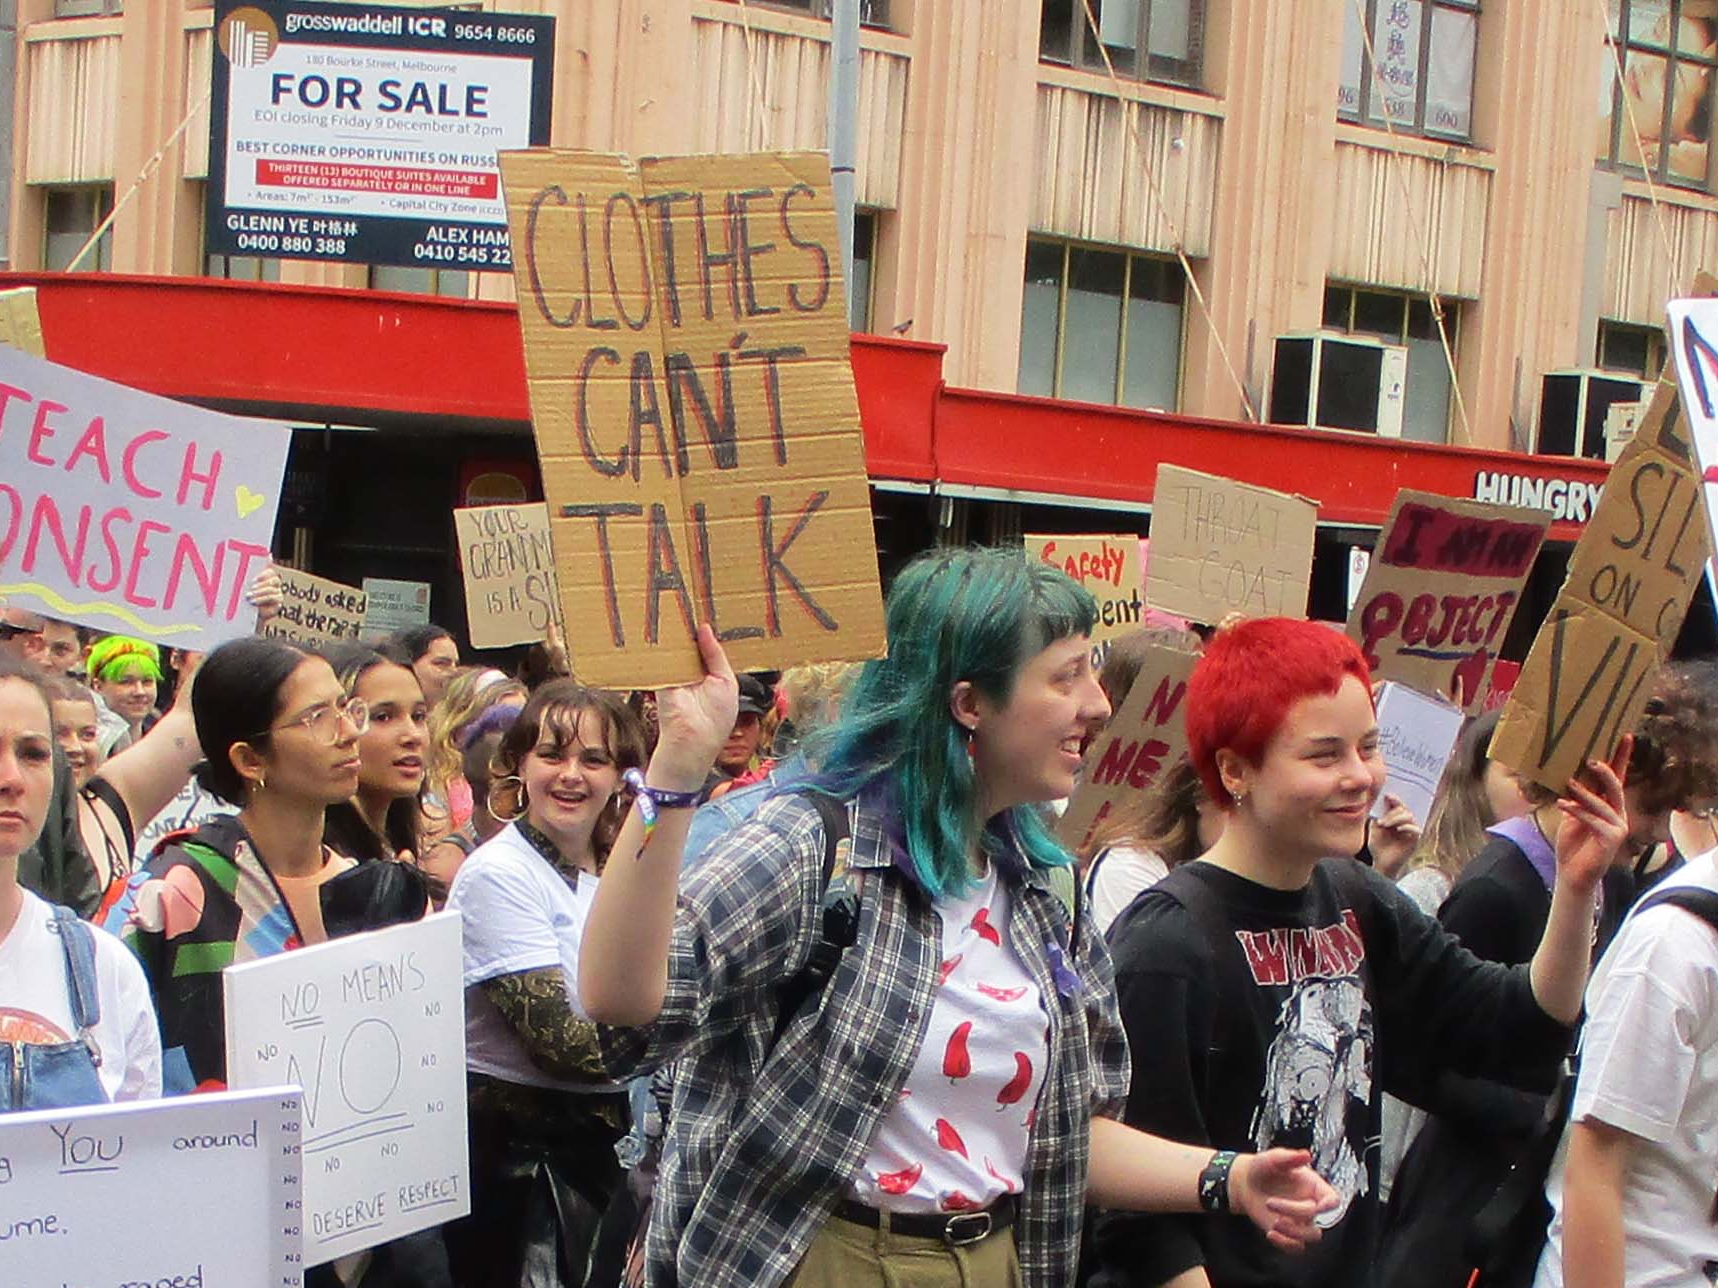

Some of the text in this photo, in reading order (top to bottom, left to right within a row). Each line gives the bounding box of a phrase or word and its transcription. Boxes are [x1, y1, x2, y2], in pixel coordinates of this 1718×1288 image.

[285, 13, 536, 43] grosswaddell ICR 9654 8666
[326, 55, 363, 69] Bourke
[402, 60, 458, 73] Melbourne
[271, 73, 490, 118] FOR SALE
[279, 111, 328, 128] closing
[331, 113, 372, 130] Friday
[374, 117, 384, 130] 9
[386, 117, 454, 134] December
[456, 123, 471, 135] at
[473, 124, 503, 138] 2pm
[236, 141, 458, 165] BEST CORNER OPPORTUNITIES ON
[268, 163, 319, 175] THIRTEEN
[342, 167, 394, 180] BOUTIQUE
[395, 170, 432, 182] SUITES
[433, 172, 486, 185] AVAILABLE
[283, 175, 471, 196] OFFERED SEPARATELY OR IN ONE LINE
[389, 198, 477, 214] Capital City Zone
[227, 216, 309, 233] GLENN YE
[426, 226, 469, 244] ALEX
[238, 235, 346, 254] 0400 880 388
[414, 244, 488, 263] 0410 545
[524, 180, 831, 331] CLOTHES
[575, 332, 807, 483] CAN'T
[468, 509, 528, 538] YOUR
[1171, 485, 1282, 552] THROAT
[559, 489, 839, 649] TALK
[1041, 541, 1125, 588] Safety
[1198, 550, 1293, 617] GOAT
[1589, 564, 1642, 619] ON
[325, 585, 367, 615] asked
[486, 586, 522, 615] IS A
[281, 951, 427, 1022] NO MEANS
[425, 1001, 441, 1017] NO
[257, 1045, 278, 1063] NO
[421, 1054, 437, 1068] NO
[286, 1018, 402, 1129] NO
[427, 1100, 444, 1114] NO
[172, 1119, 259, 1151] around
[325, 1143, 399, 1173] NO NO
[312, 1174, 460, 1237] DESERVE RESPECT
